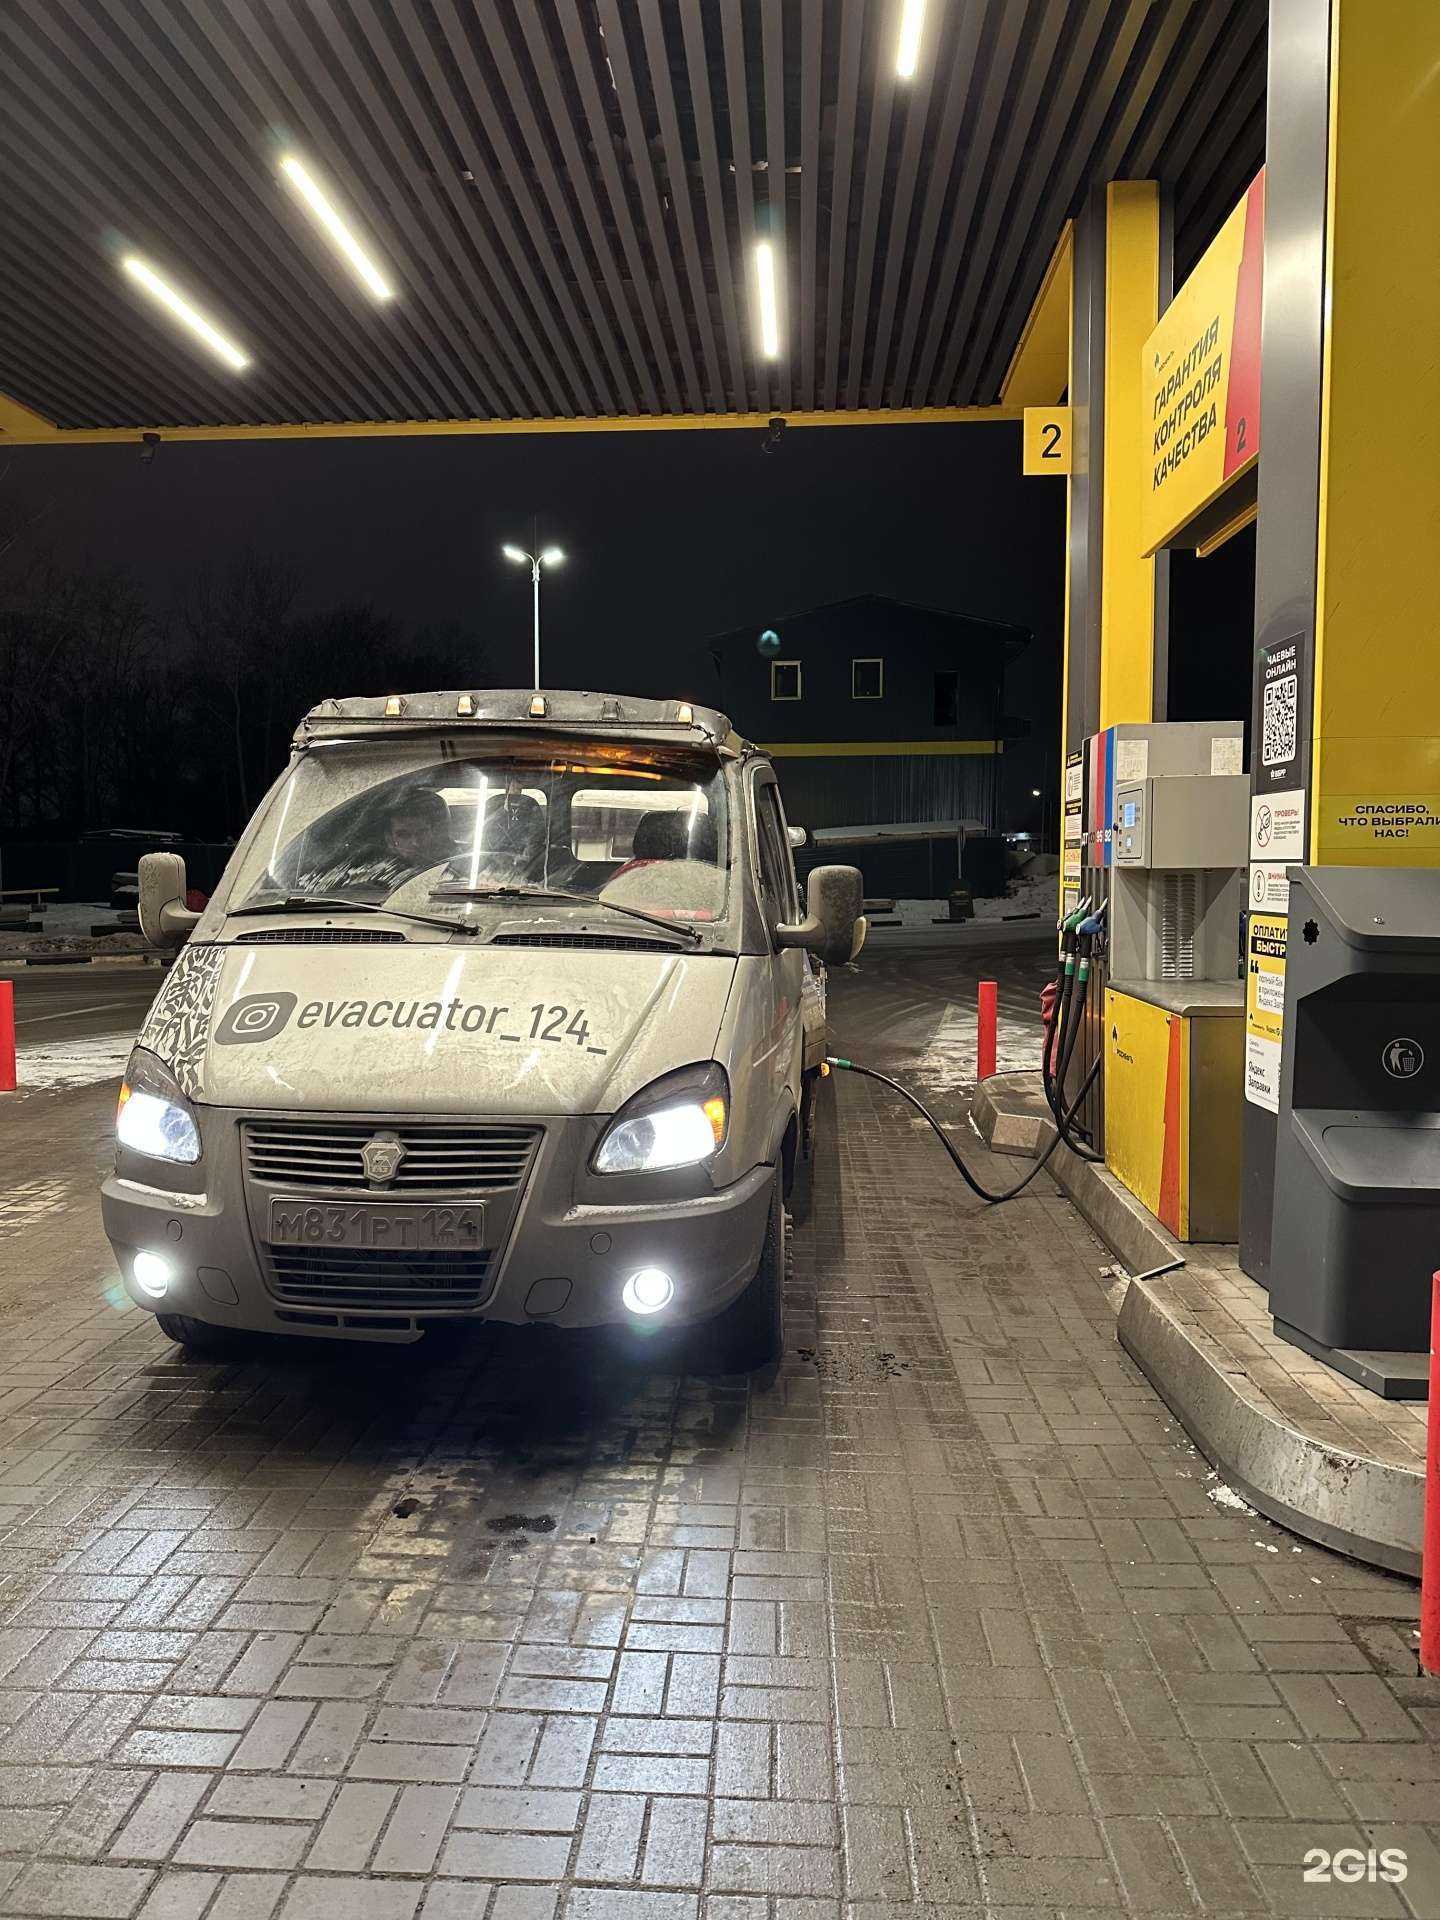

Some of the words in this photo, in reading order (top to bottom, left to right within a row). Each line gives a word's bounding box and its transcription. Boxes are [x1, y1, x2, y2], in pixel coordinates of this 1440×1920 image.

[1153, 315, 1219, 420] ГАРАНТИЯ
[1153, 352, 1222, 455] КОНТРОЛЯ
[1042, 424, 1061, 458] 2
[1237, 416, 1246, 453] 2
[1153, 402, 1216, 491] КАЧЕСТВА
[1267, 645, 1296, 665] ЧАЕВЫЕ
[1265, 658, 1297, 679] ОНЛАЙН
[1355, 805, 1430, 815] СПАСИБО,
[1338, 817, 1368, 826] ЧТО
[1104, 828, 1112, 843] 92
[1374, 829, 1409, 838] НАС!
[1256, 940, 1286, 956] БЫСТР
[299, 997, 608, 1056] evacuator_124_
